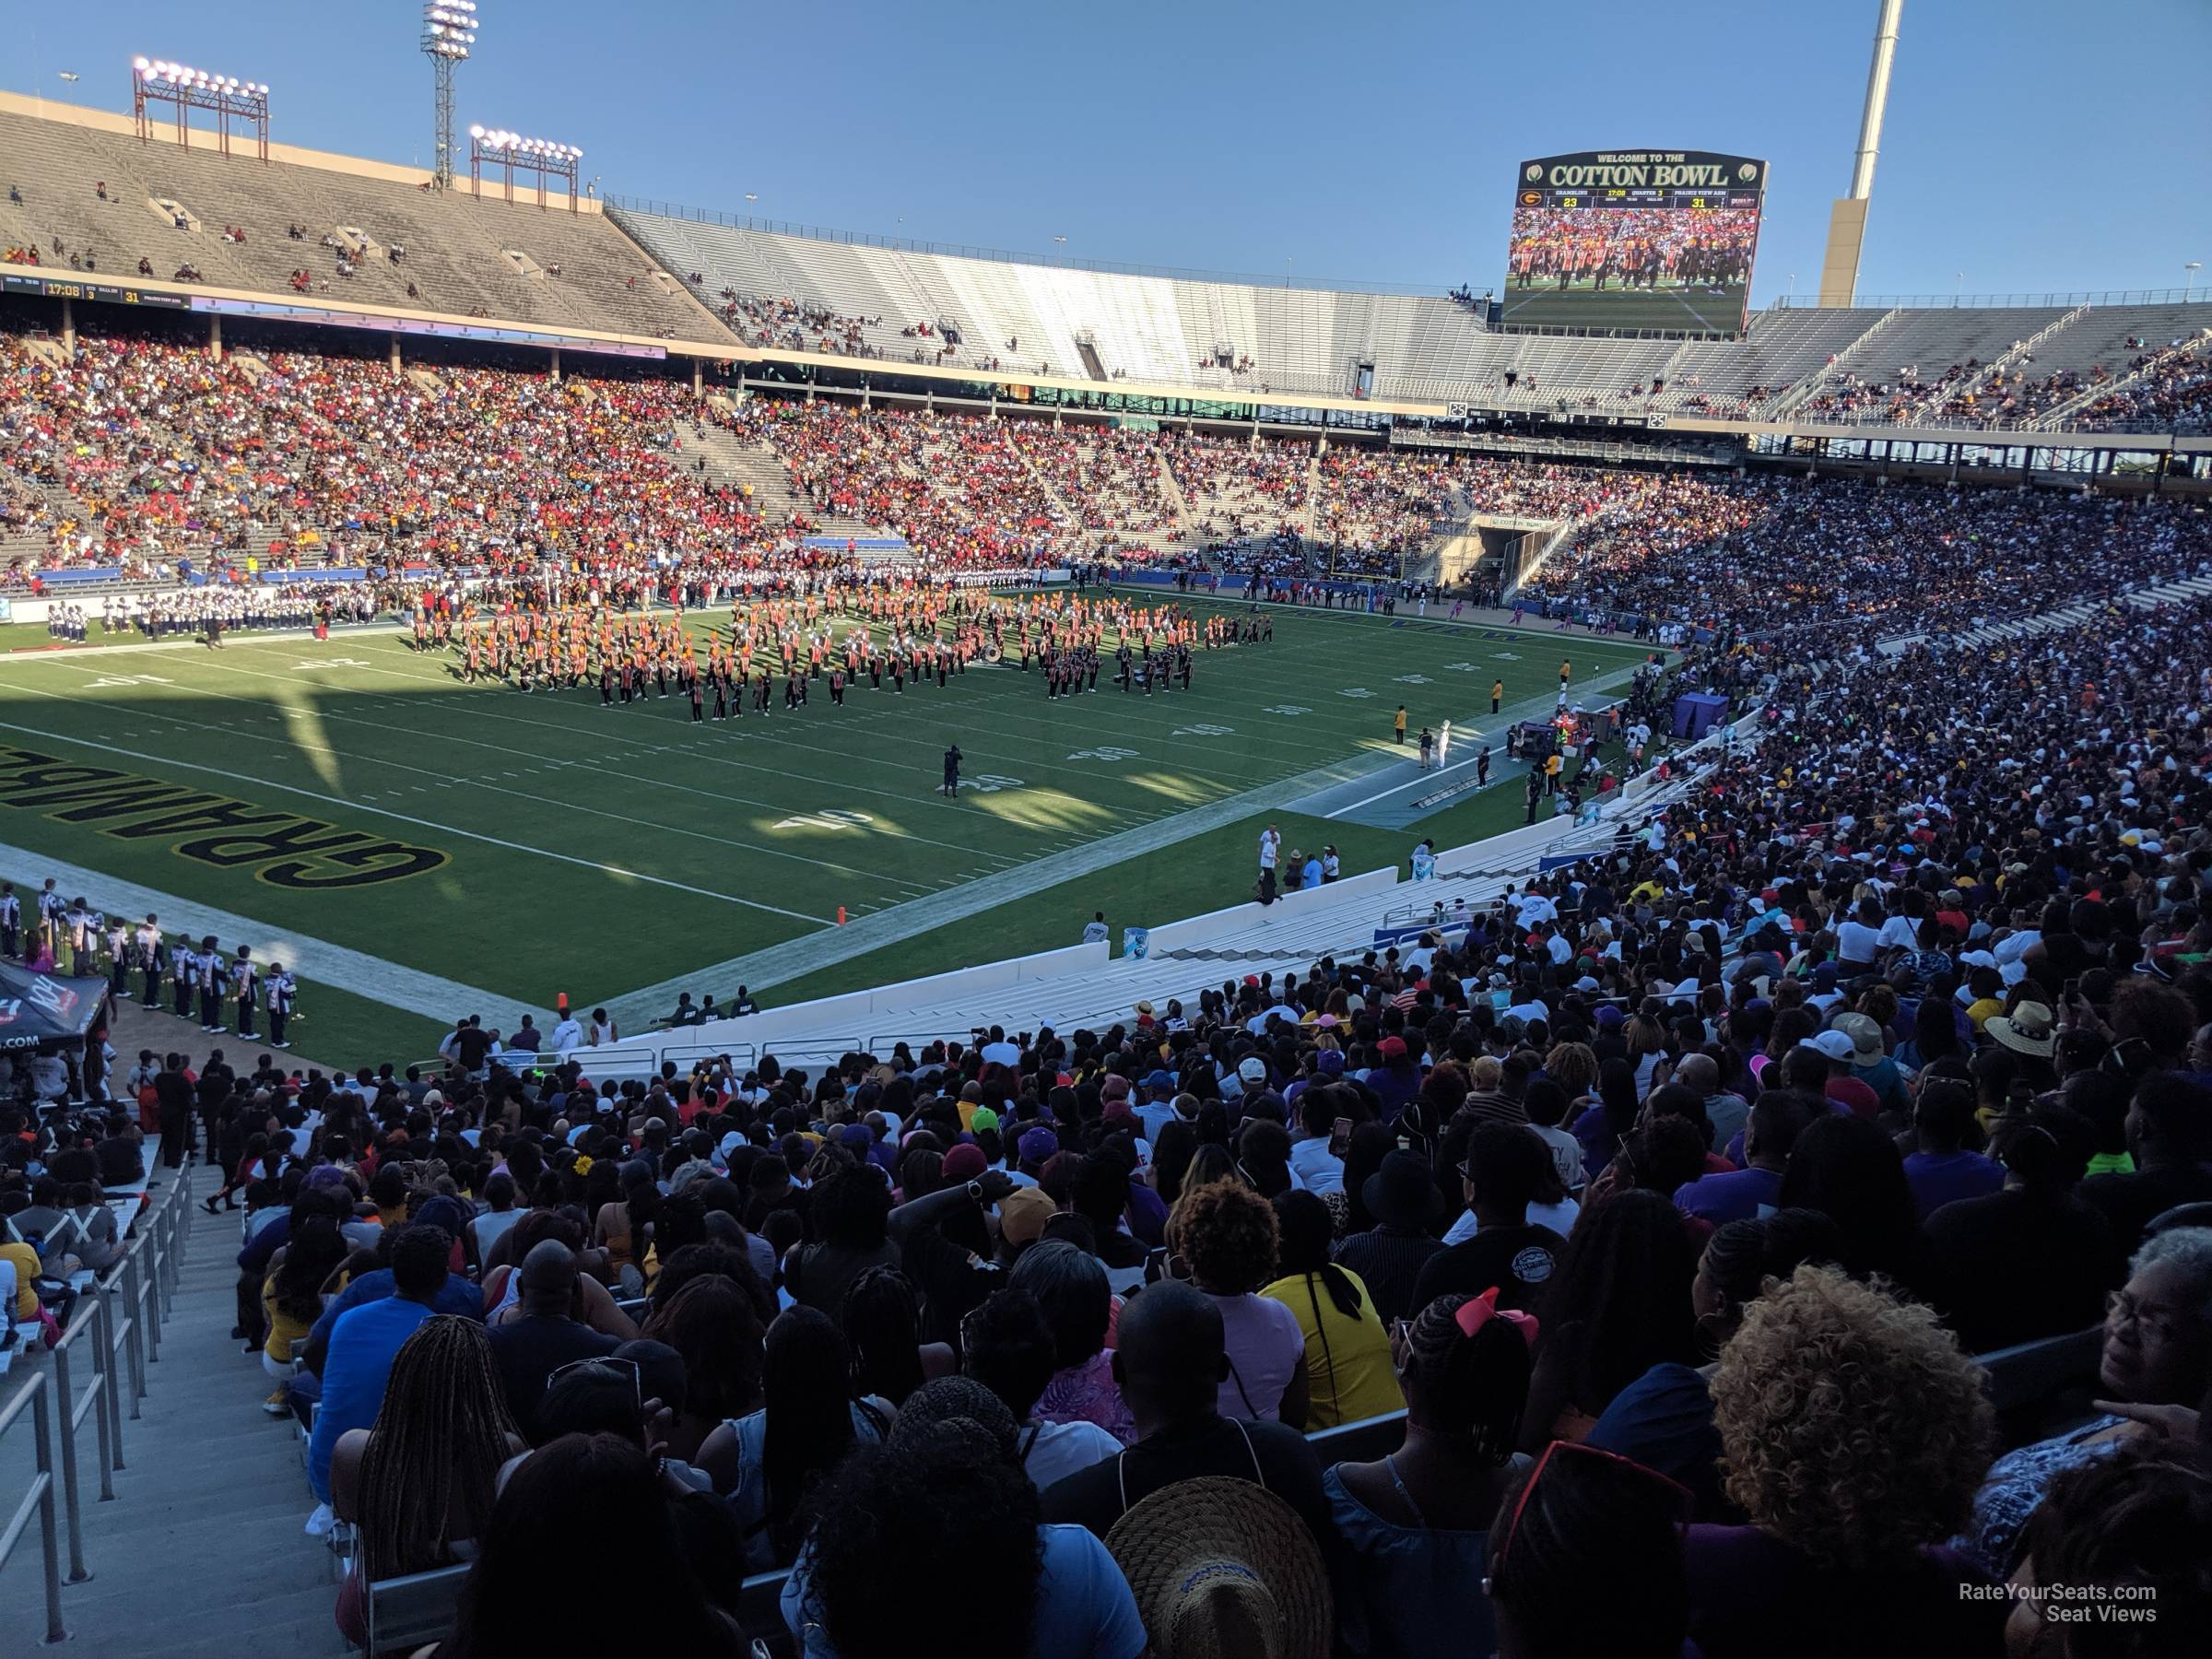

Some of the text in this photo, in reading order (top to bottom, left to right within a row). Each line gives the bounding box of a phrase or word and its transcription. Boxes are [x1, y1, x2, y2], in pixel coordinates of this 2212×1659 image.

[1597, 153, 1686, 163] WELCOME TO THE
[1549, 165, 1729, 186] COTTON BOWL
[1563, 197, 1578, 207] 23
[1691, 198, 1705, 208] 31
[48, 283, 80, 297] 17:08
[88, 290, 95, 300] 3
[125, 291, 140, 303] 31
[1451, 404, 1465, 416] 25
[1607, 417, 1618, 426] 23
[1650, 415, 1665, 427] 25
[788, 808, 875, 830] 10
